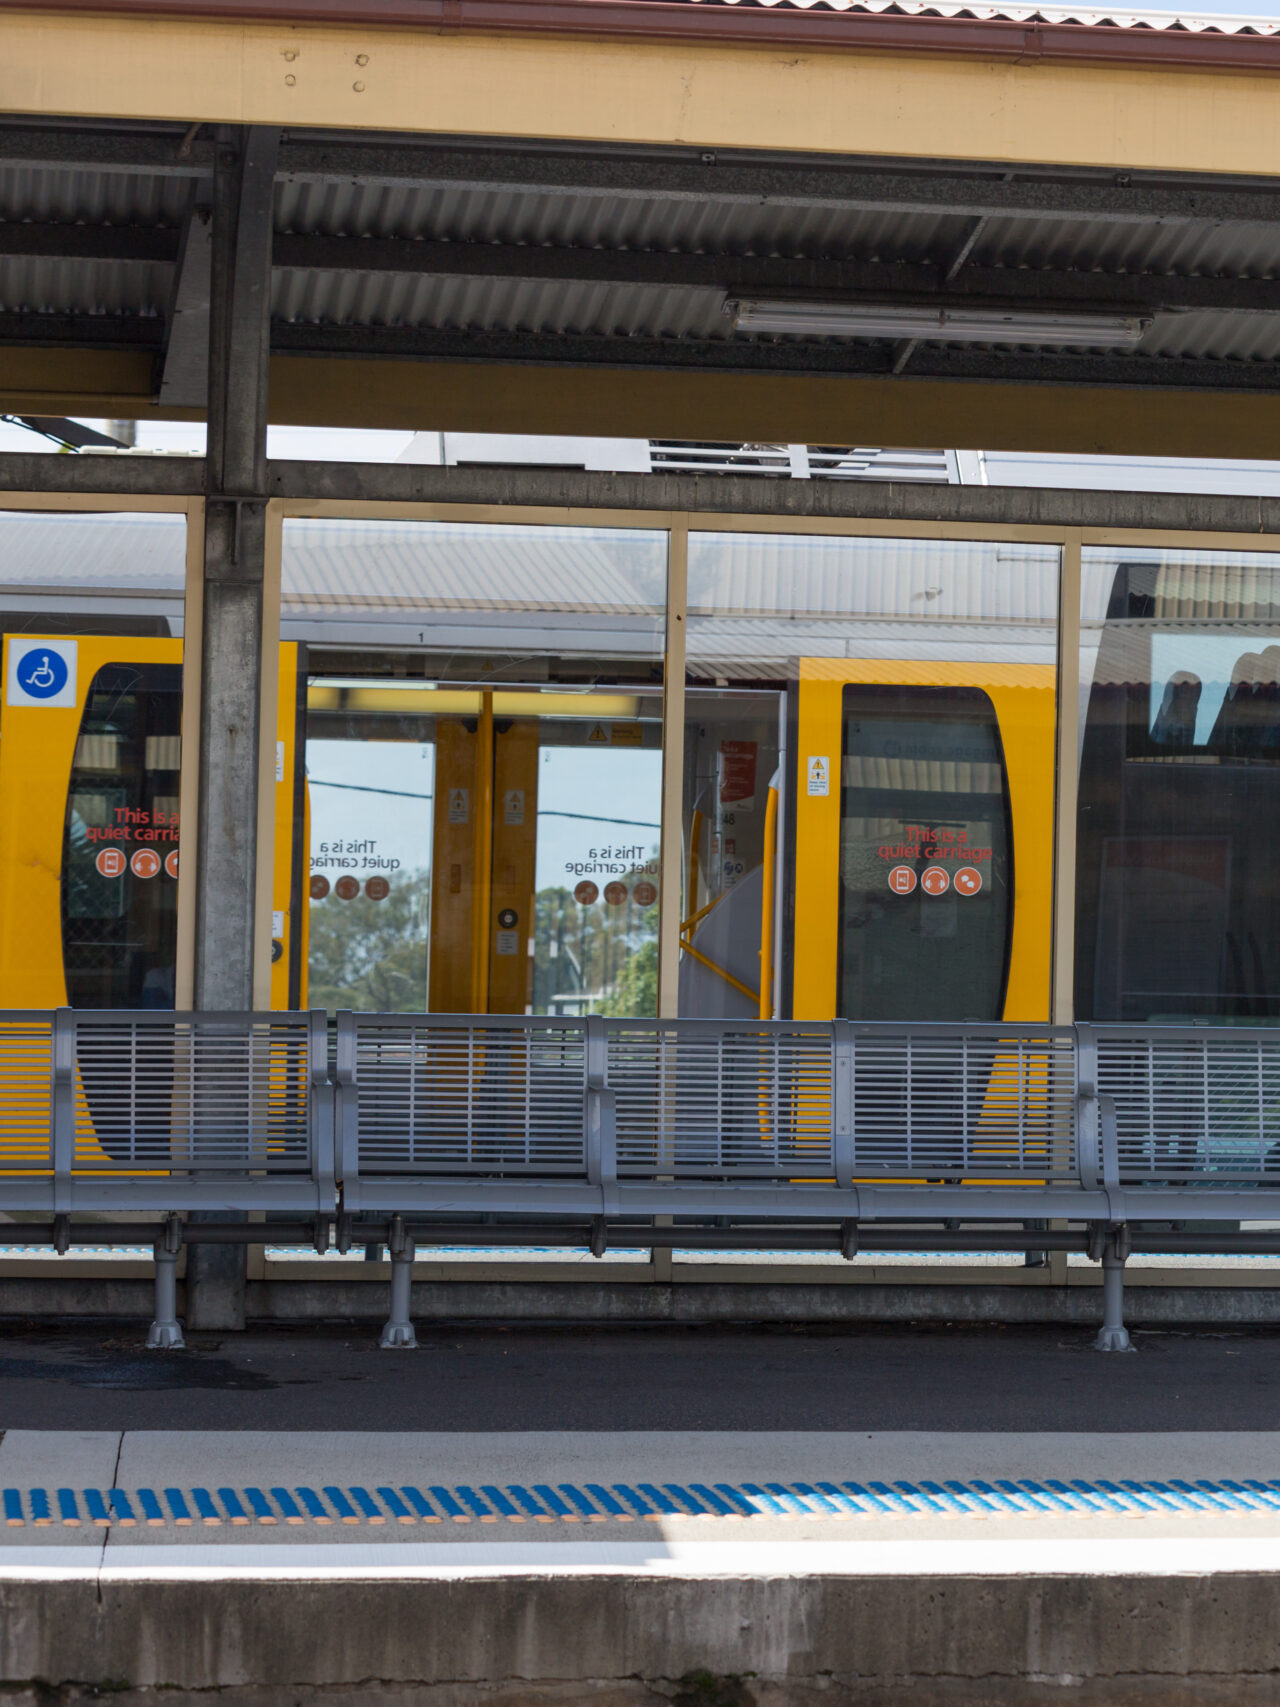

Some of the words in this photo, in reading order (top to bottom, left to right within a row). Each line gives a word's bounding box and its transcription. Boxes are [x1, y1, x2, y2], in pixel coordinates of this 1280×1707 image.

[417, 631, 424, 643] 1
[113, 807, 150, 824] This
[152, 808, 167, 824] is
[169, 812, 180, 824] a
[86, 824, 131, 843] quiet
[905, 826, 939, 843] This
[942, 827, 955, 843] is
[958, 830, 968, 843] a
[878, 842, 921, 861] quiet
[924, 844, 993, 863] carriage
